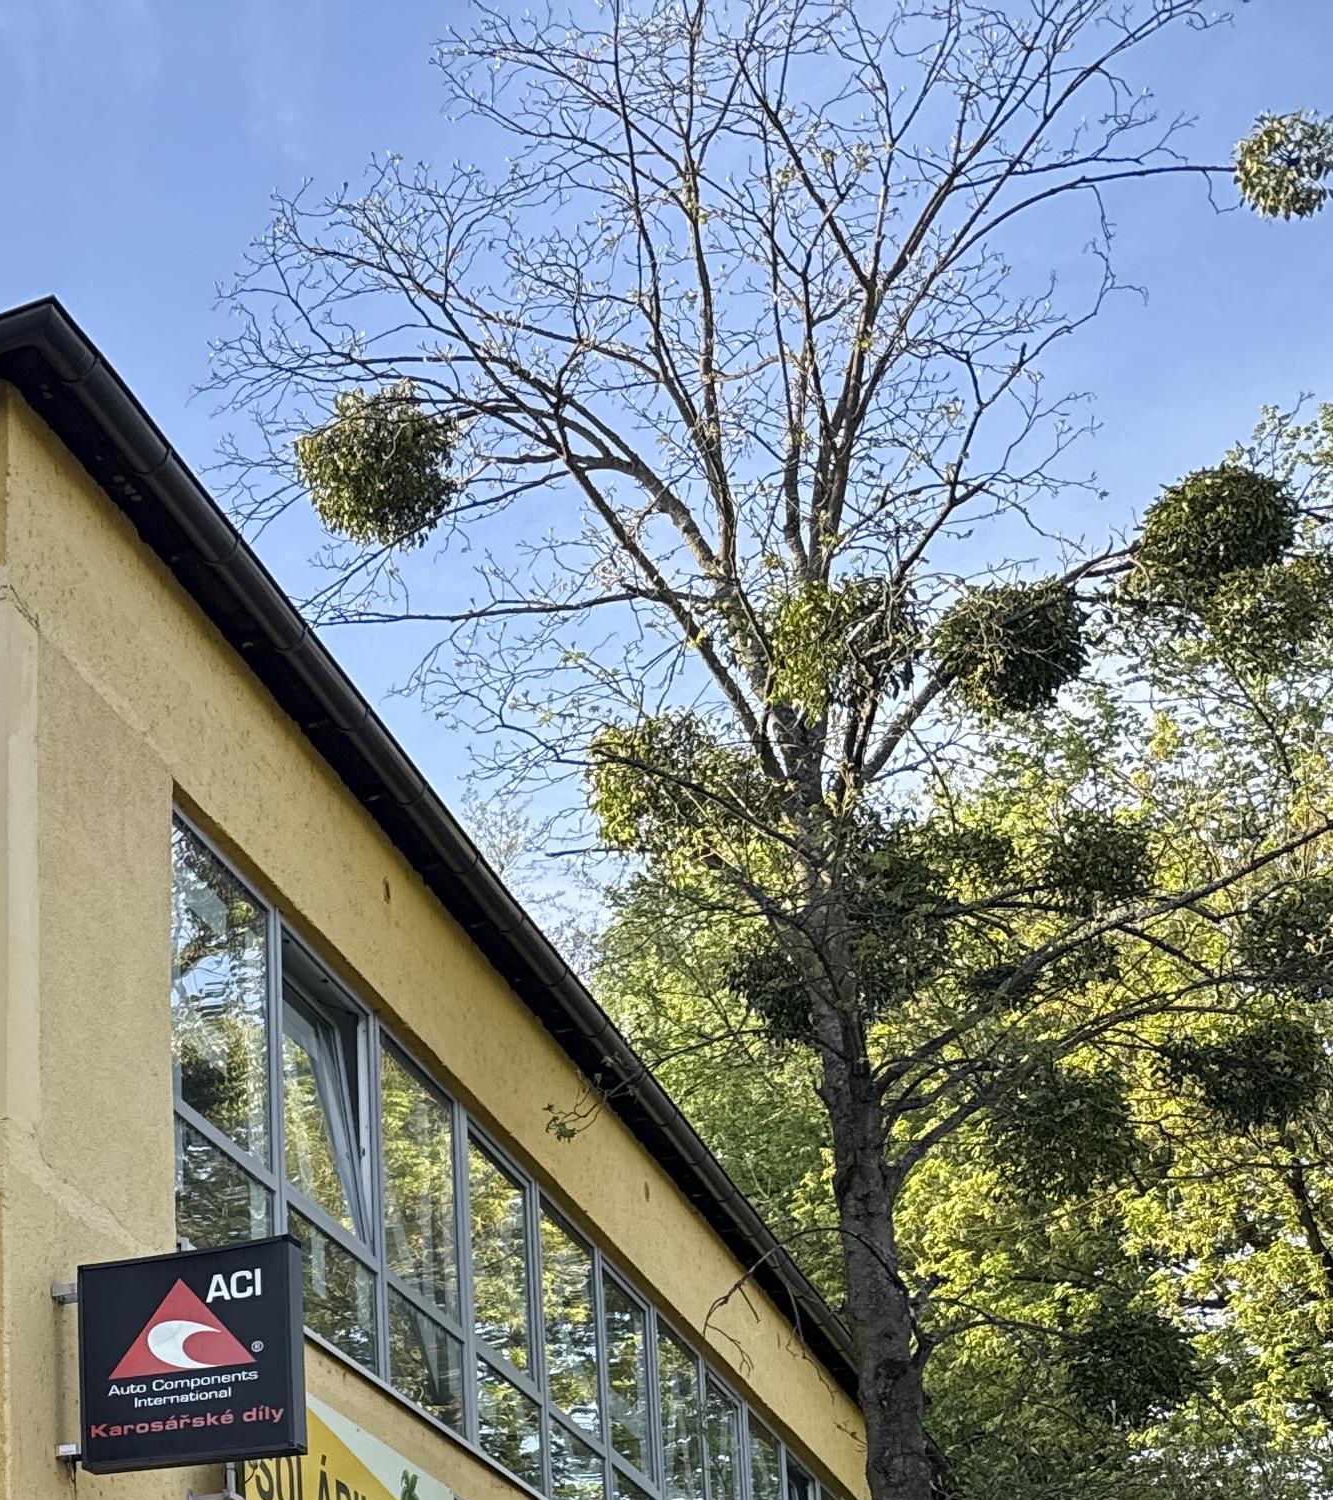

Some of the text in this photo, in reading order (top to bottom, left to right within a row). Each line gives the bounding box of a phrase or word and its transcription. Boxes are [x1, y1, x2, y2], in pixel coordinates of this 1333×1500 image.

[205, 1268, 262, 1303] ACI
[107, 1369, 258, 1397] Auto Components
[133, 1386, 232, 1408] International
[90, 1405, 284, 1439] Karosářské díly
